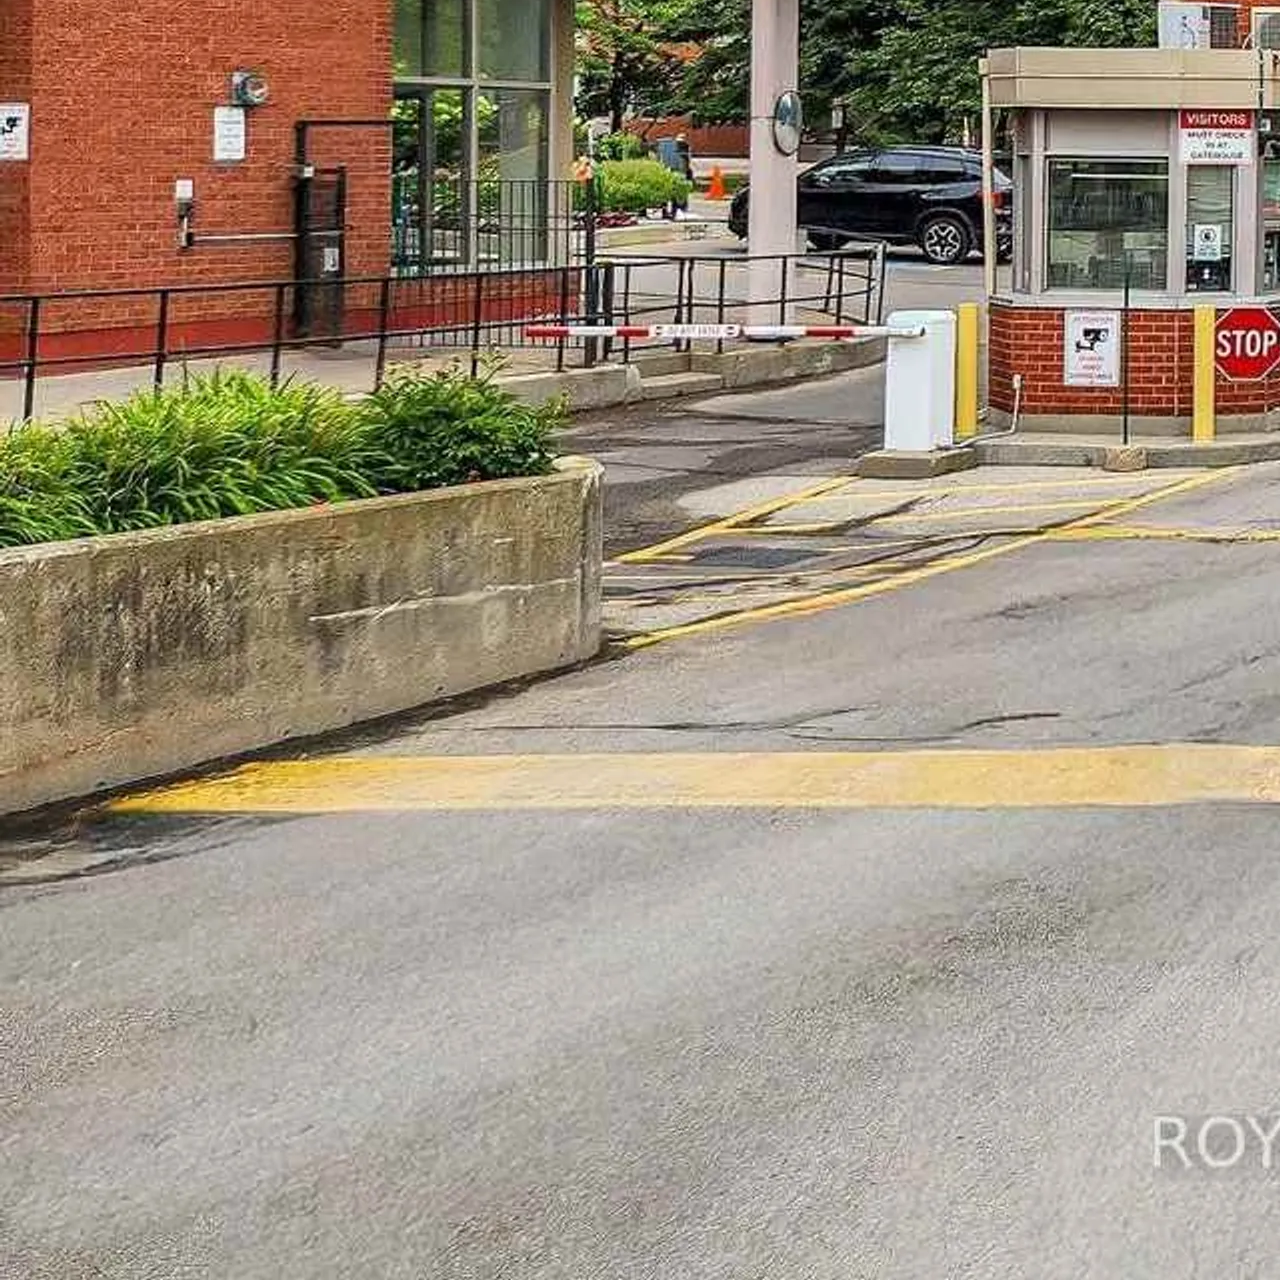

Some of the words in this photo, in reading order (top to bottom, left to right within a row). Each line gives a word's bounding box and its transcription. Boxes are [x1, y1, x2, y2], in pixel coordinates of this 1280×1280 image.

[1186, 113, 1247, 125] VISITORS
[1187, 130, 1213, 139] MUST
[1217, 329, 1277, 358] STOP
